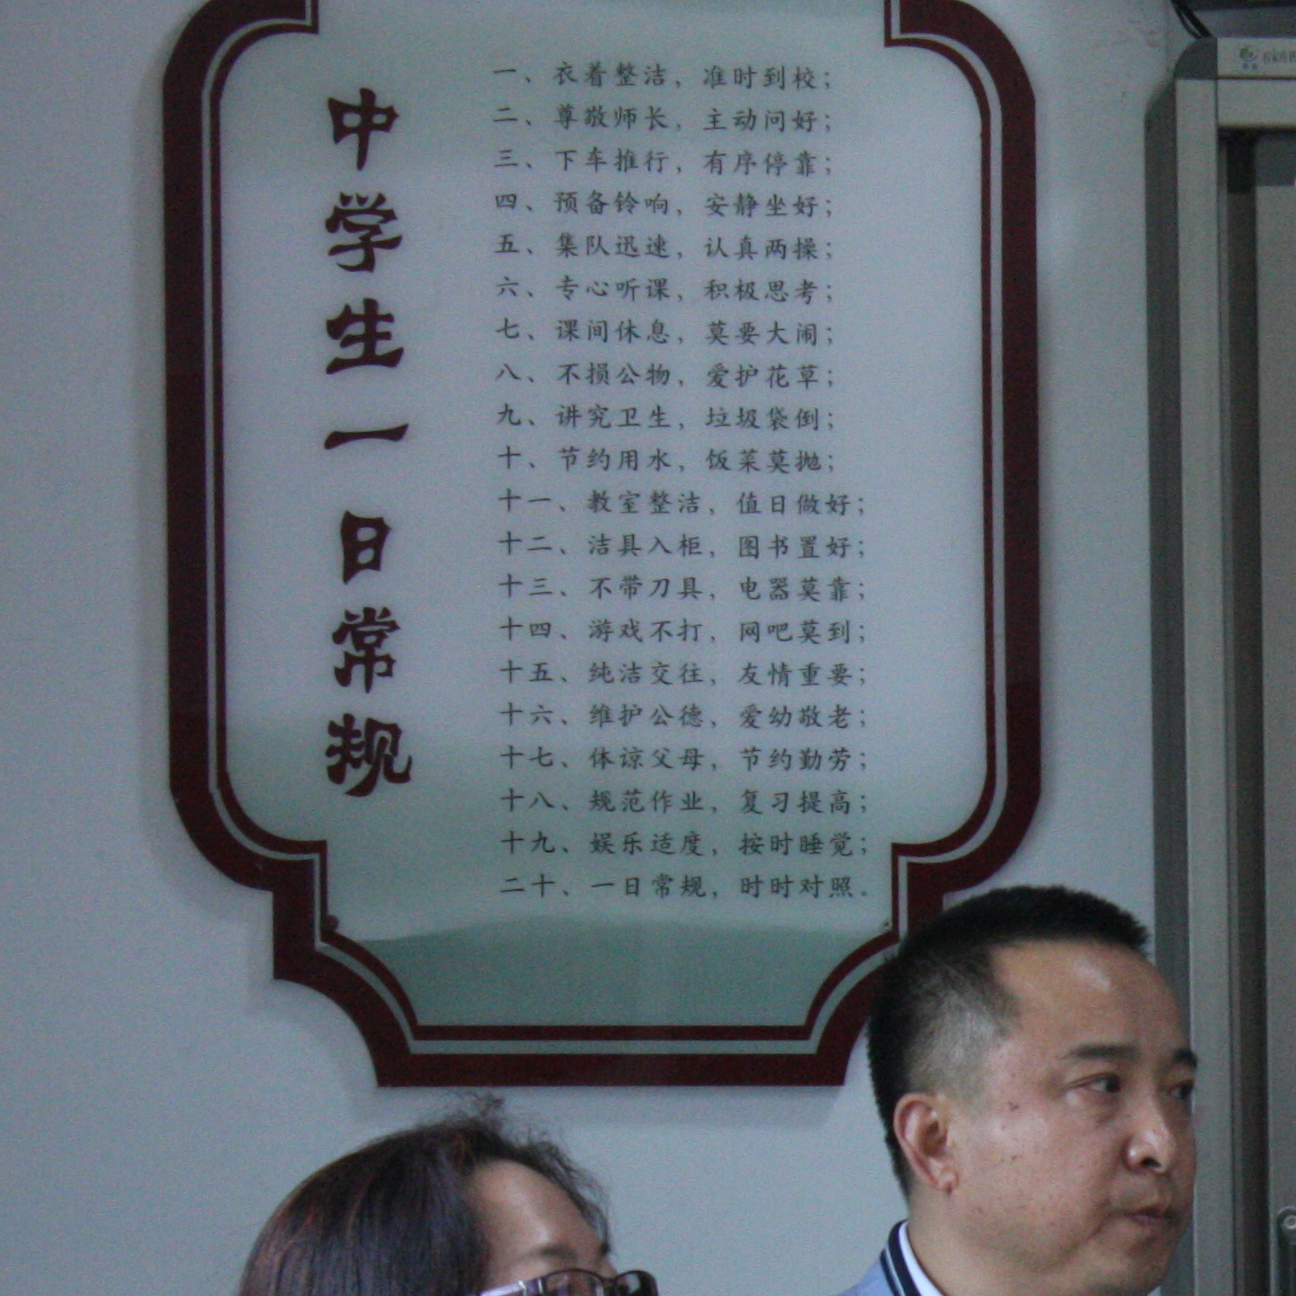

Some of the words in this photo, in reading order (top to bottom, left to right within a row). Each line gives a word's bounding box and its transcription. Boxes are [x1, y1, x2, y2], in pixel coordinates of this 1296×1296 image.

[324, 88, 412, 797] 中学生一日常规
